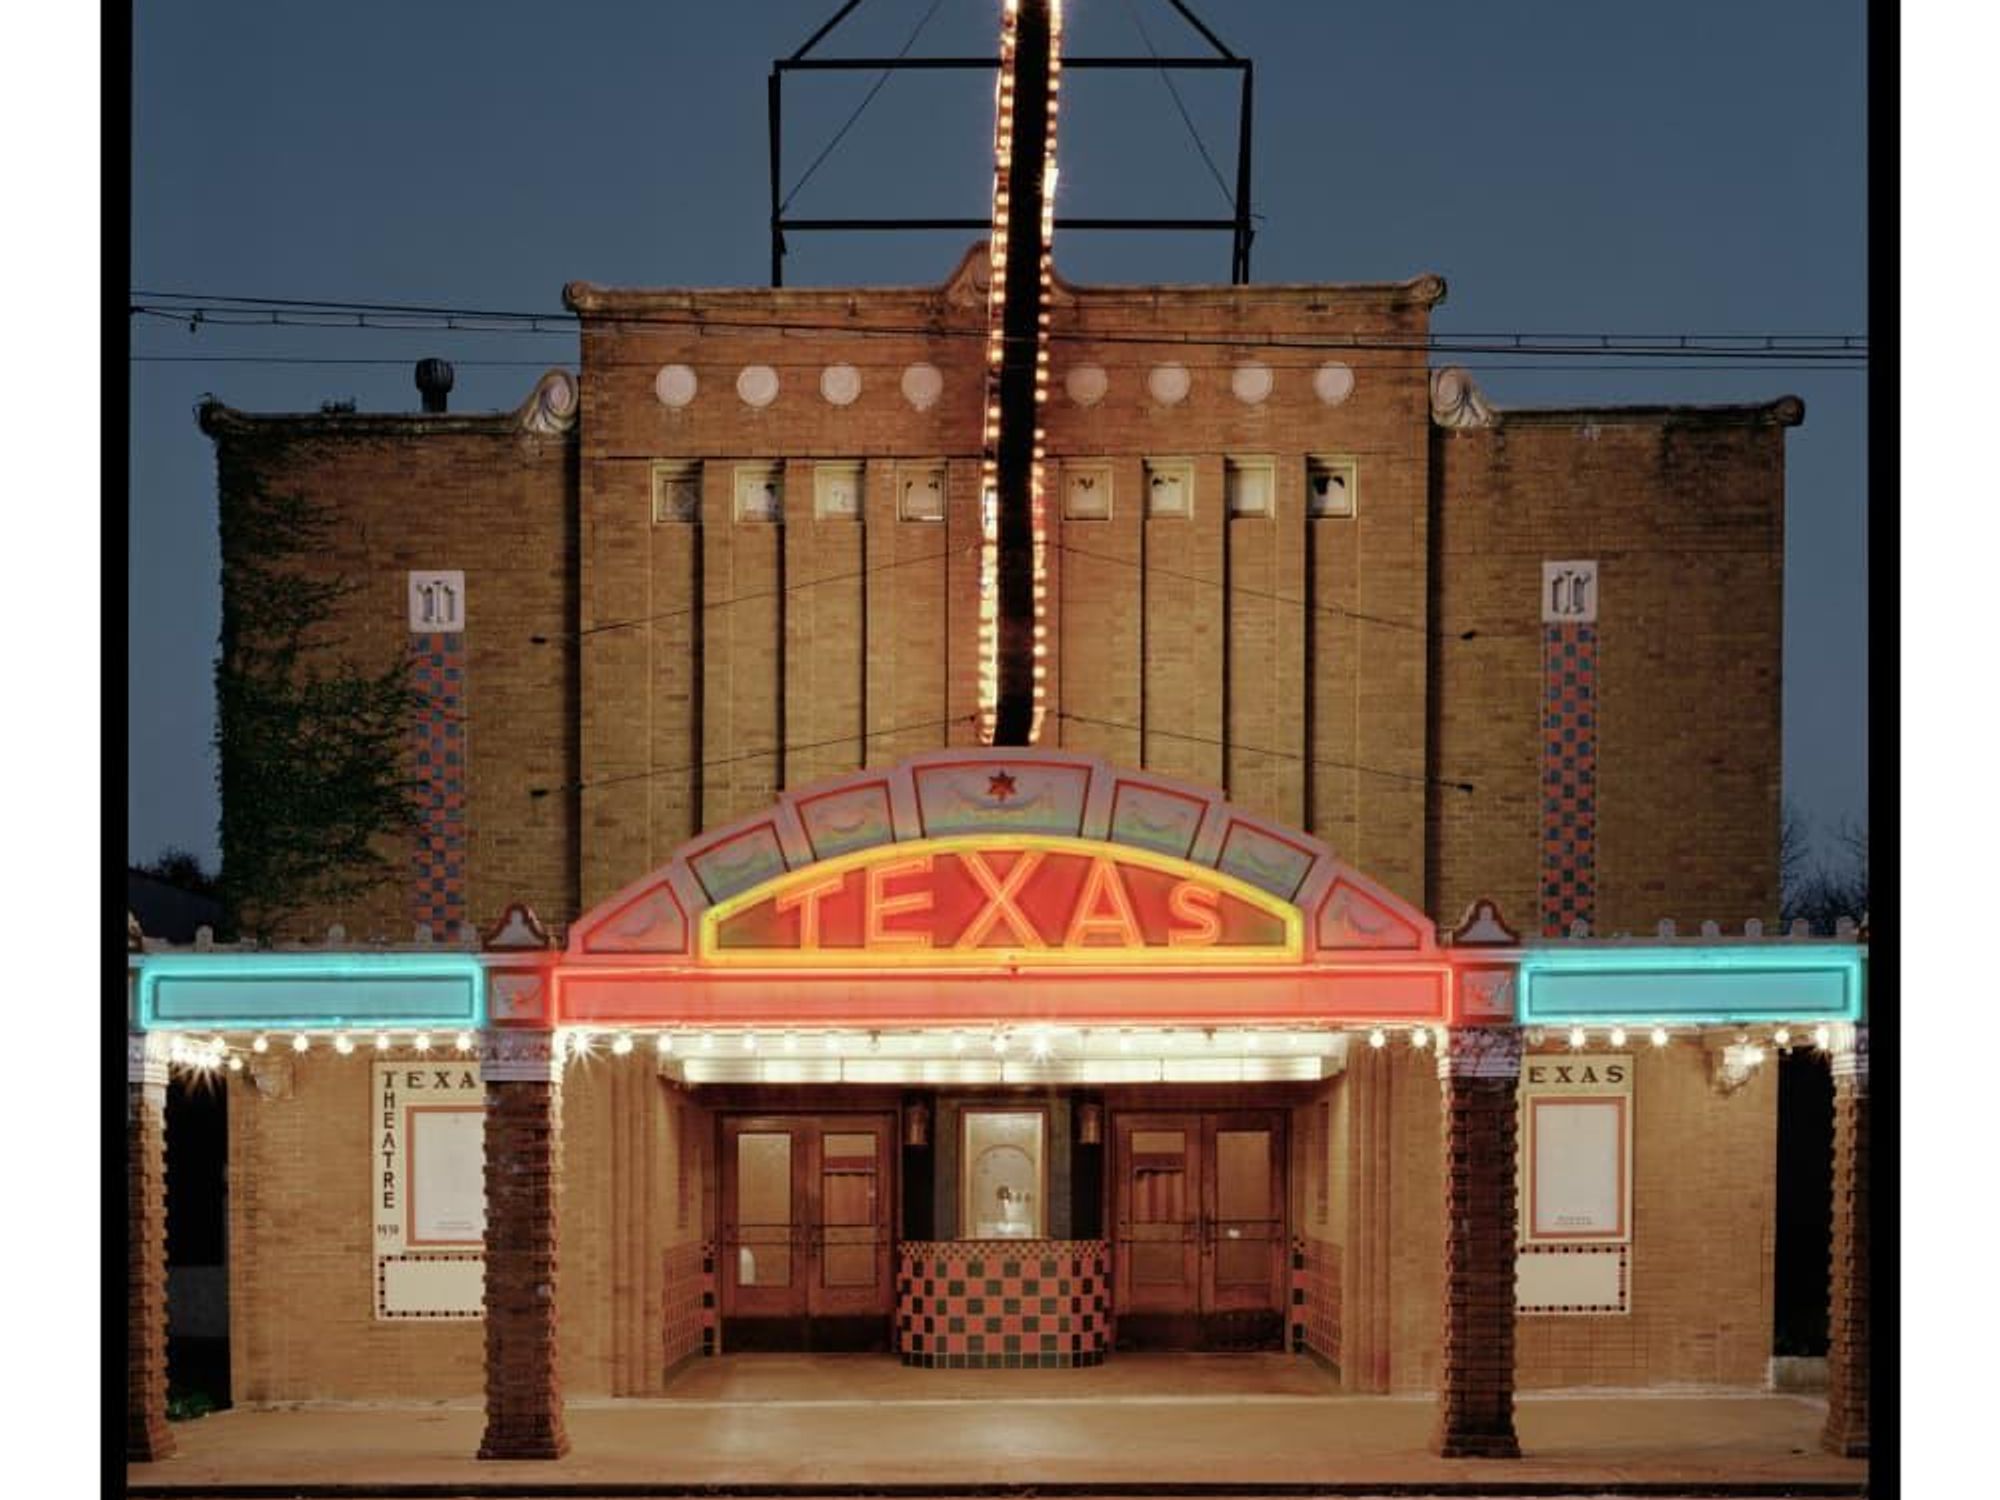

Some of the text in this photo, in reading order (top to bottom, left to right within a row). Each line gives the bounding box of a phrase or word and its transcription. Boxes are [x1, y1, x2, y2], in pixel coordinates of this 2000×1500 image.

[776, 850, 1221, 949] TEXAS
[382, 1070, 477, 1089] TEXA
[1527, 1066, 1625, 1084] EXAS
